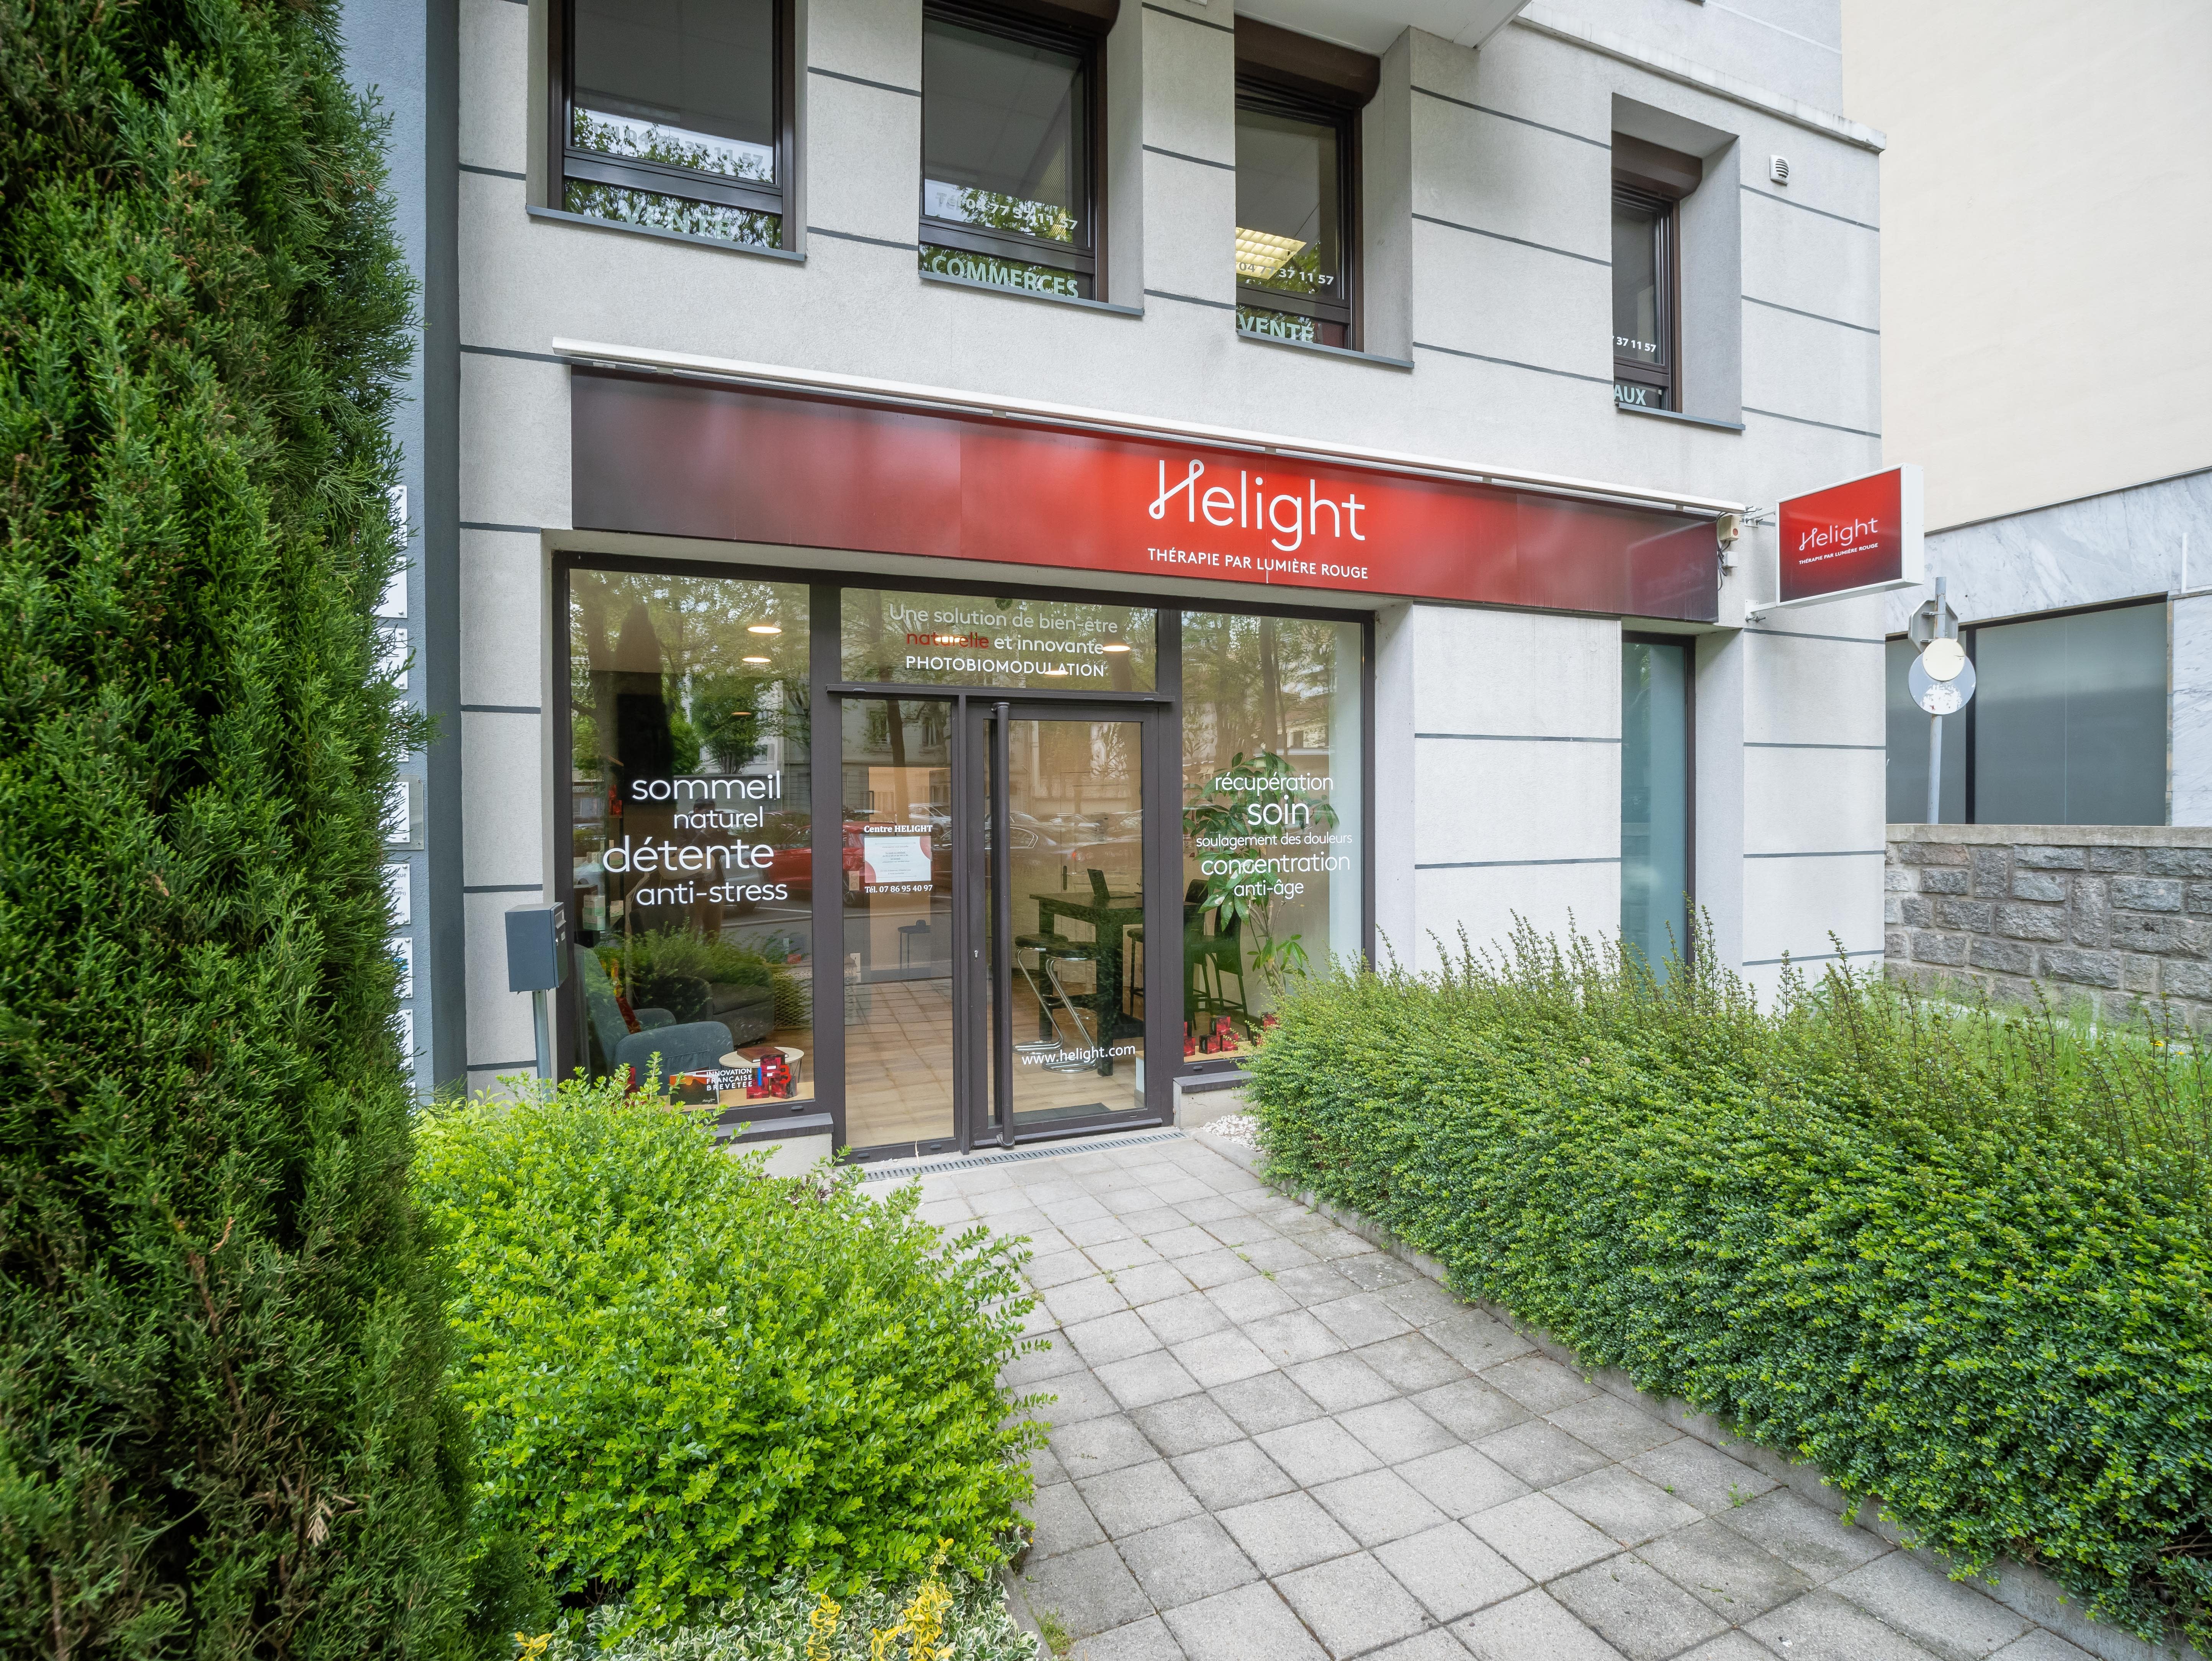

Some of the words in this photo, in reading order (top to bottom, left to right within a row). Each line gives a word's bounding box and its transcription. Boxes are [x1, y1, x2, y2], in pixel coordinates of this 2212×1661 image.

[937, 192, 961, 207] Tél
[990, 203, 1009, 215] 77
[1013, 208, 1033, 220] 37
[1037, 213, 1054, 225] 11
[1060, 218, 1078, 230] 57
[932, 256, 1078, 298] COMMERCES
[1239, 262, 1255, 273] 04
[1279, 269, 1296, 279] 37
[1299, 272, 1314, 282] 11
[1318, 275, 1334, 285] 57
[1616, 336, 1629, 347] 37
[1631, 340, 1641, 350] 11
[1644, 343, 1656, 352] 57
[1149, 459, 1365, 551] Helight
[1799, 517, 1878, 551] Helight
[1148, 547, 1220, 566] THÉRAPIE
[1225, 555, 1252, 569] PAR
[1257, 558, 1316, 575] LUMIÈRE
[1321, 564, 1368, 579] ROUGE
[1799, 555, 1823, 565] THÉRAPIE
[1835, 547, 1857, 557] LUMIÈRE
[1859, 543, 1878, 551] ROUGE
[889, 604, 929, 622] Une
[934, 608, 1007, 627] solution
[1012, 613, 1034, 628] de
[1040, 614, 1118, 633] bien-être
[907, 632, 989, 649] naturelle
[994, 637, 1013, 650] et
[1018, 634, 1104, 655] innovante
[906, 656, 1104, 677] PHOTOBIOMODULATION
[632, 770, 780, 800] sommeil
[1215, 772, 1333, 796] récupération
[674, 806, 763, 829] naturel
[1247, 794, 1309, 826] soin
[1196, 834, 1278, 850] soulagement
[1281, 832, 1301, 845] des
[1304, 831, 1352, 845] douleurs
[603, 835, 774, 873] détente
[1201, 851, 1350, 875] concentration
[636, 880, 788, 906] anti-stress
[1234, 879, 1304, 899] anti-âge
[1021, 1043, 1135, 1065] www.helight.com
[707, 1068, 752, 1077] INNOVATION
[707, 1075, 753, 1084] FRANÇAISE
[707, 1081, 753, 1091] BREVETEE
